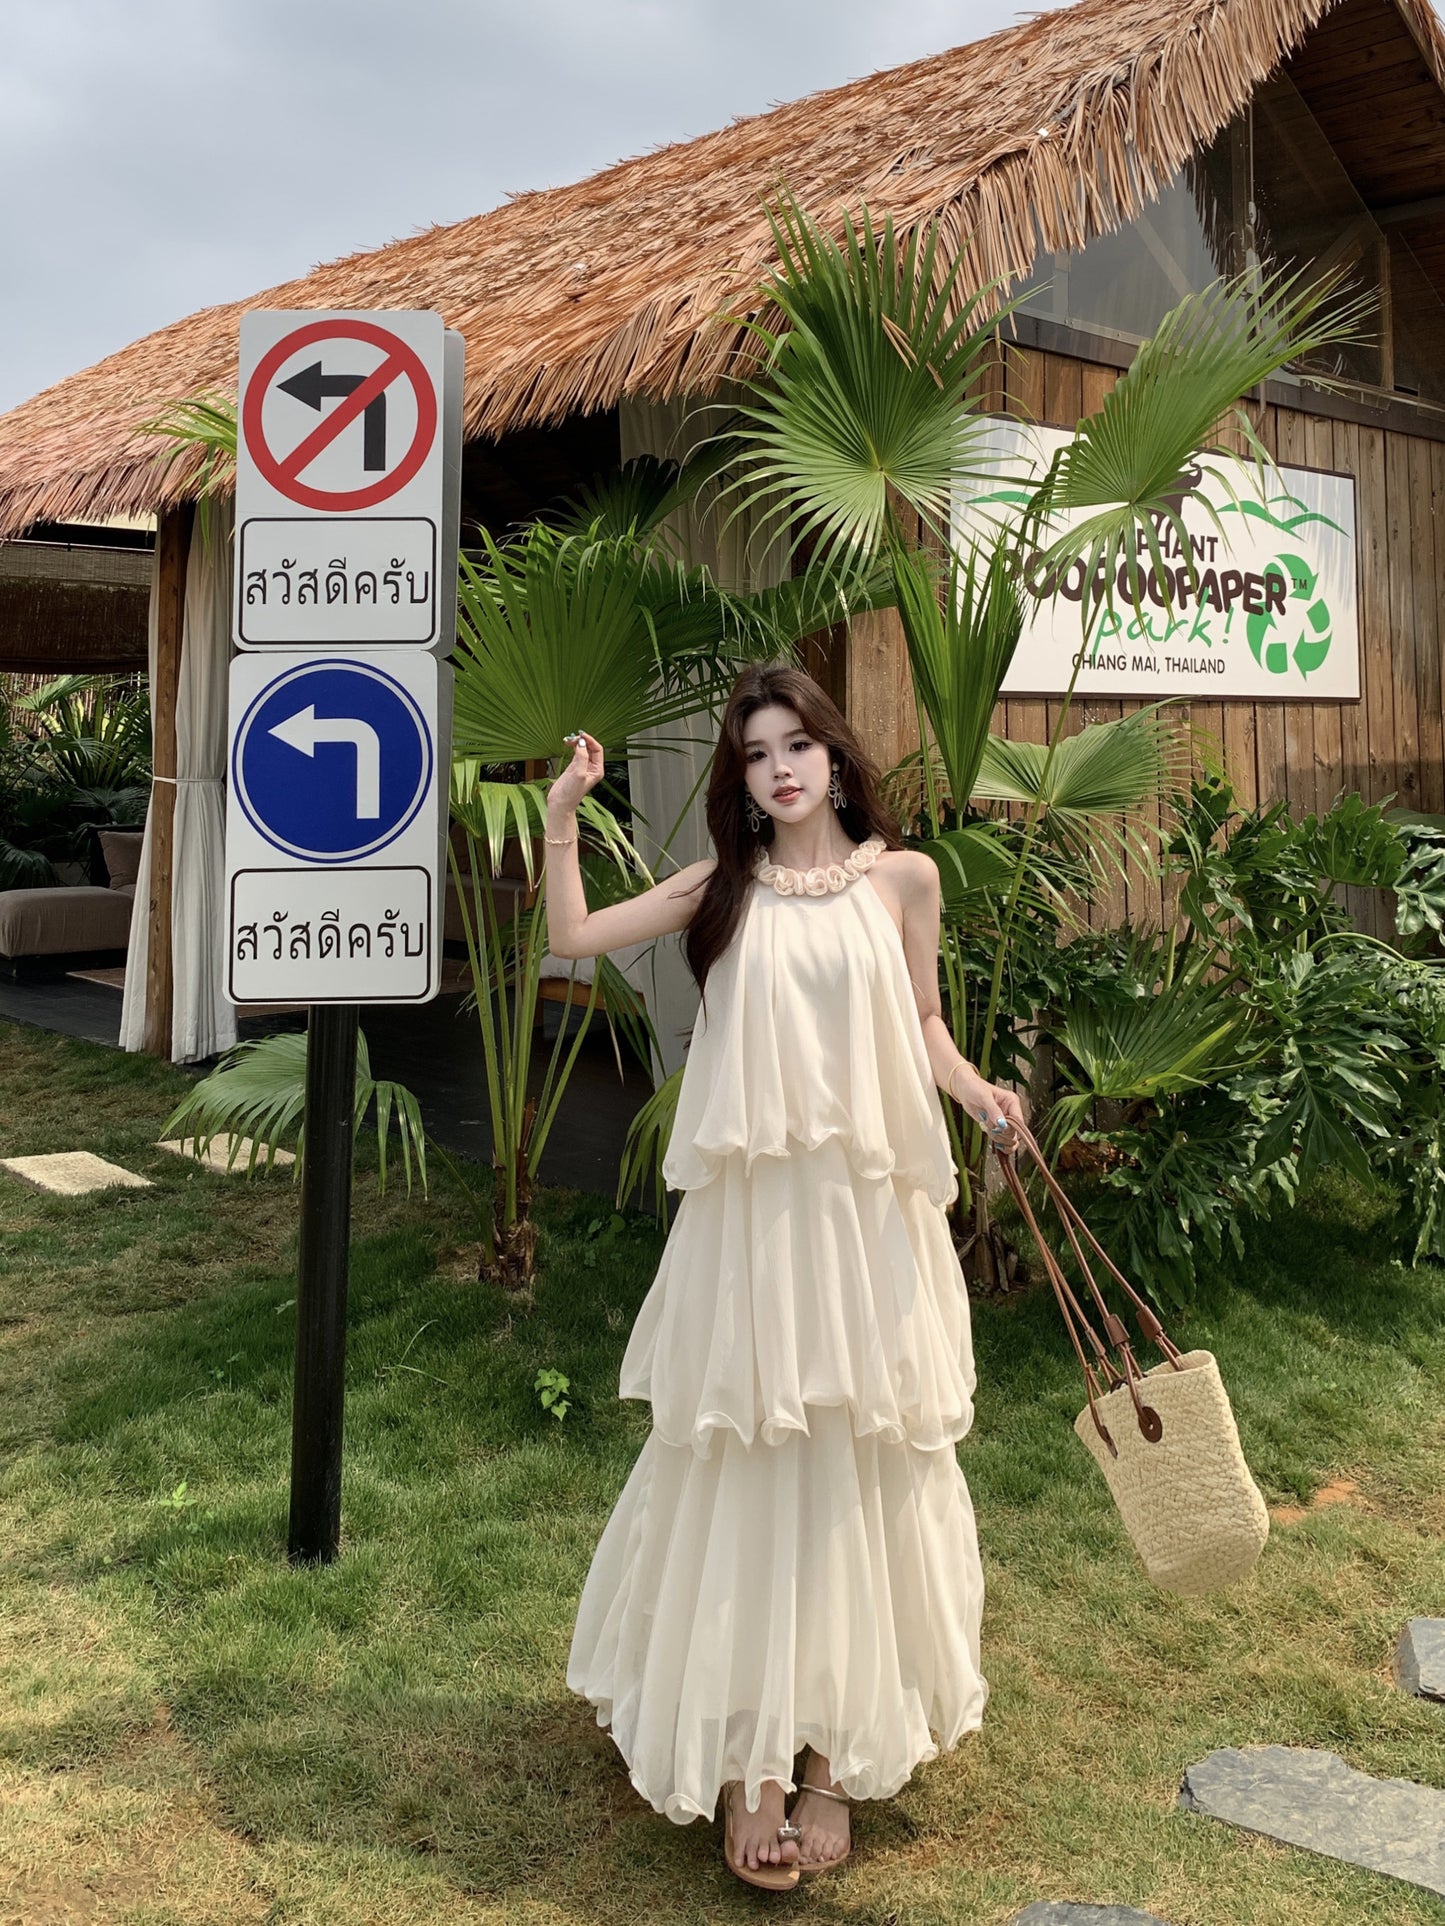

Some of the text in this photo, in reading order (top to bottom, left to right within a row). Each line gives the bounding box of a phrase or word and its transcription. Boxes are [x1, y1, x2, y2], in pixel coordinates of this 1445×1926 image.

[1092, 524, 1219, 563] PHANT
[246, 557, 430, 605] สวัสดีครับ
[1091, 586, 1234, 668] park!
[1072, 653, 1226, 675] CHIANG MAI, THAILAND
[236, 908, 425, 961] สวัสดีครับ
